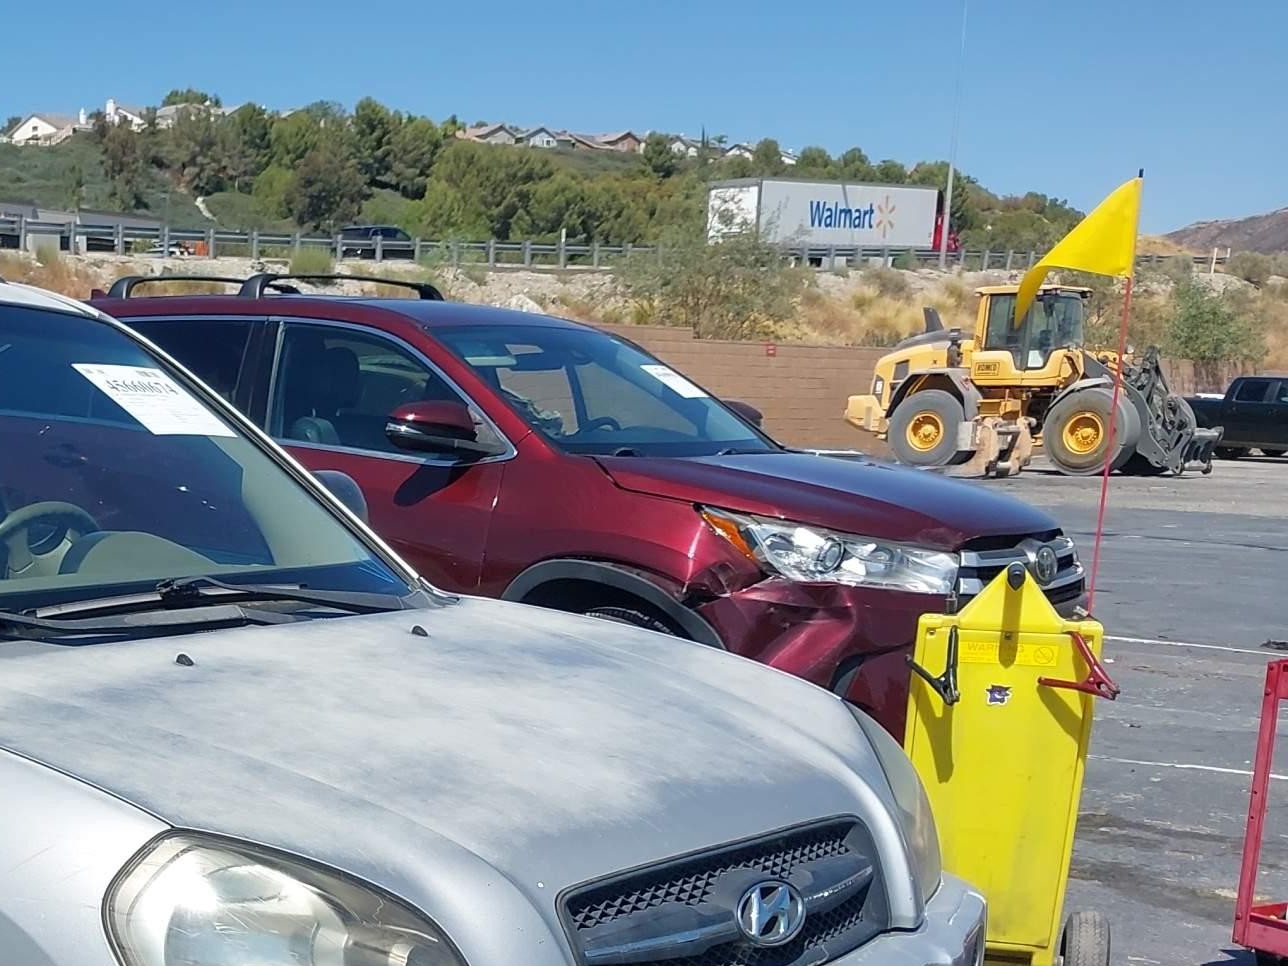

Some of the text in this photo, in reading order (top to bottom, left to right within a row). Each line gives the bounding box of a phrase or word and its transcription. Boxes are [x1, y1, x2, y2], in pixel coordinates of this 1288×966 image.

[809, 201, 874, 229] Walmart
[106, 379, 179, 395] 45660674
[967, 642, 1025, 654] WARNG
